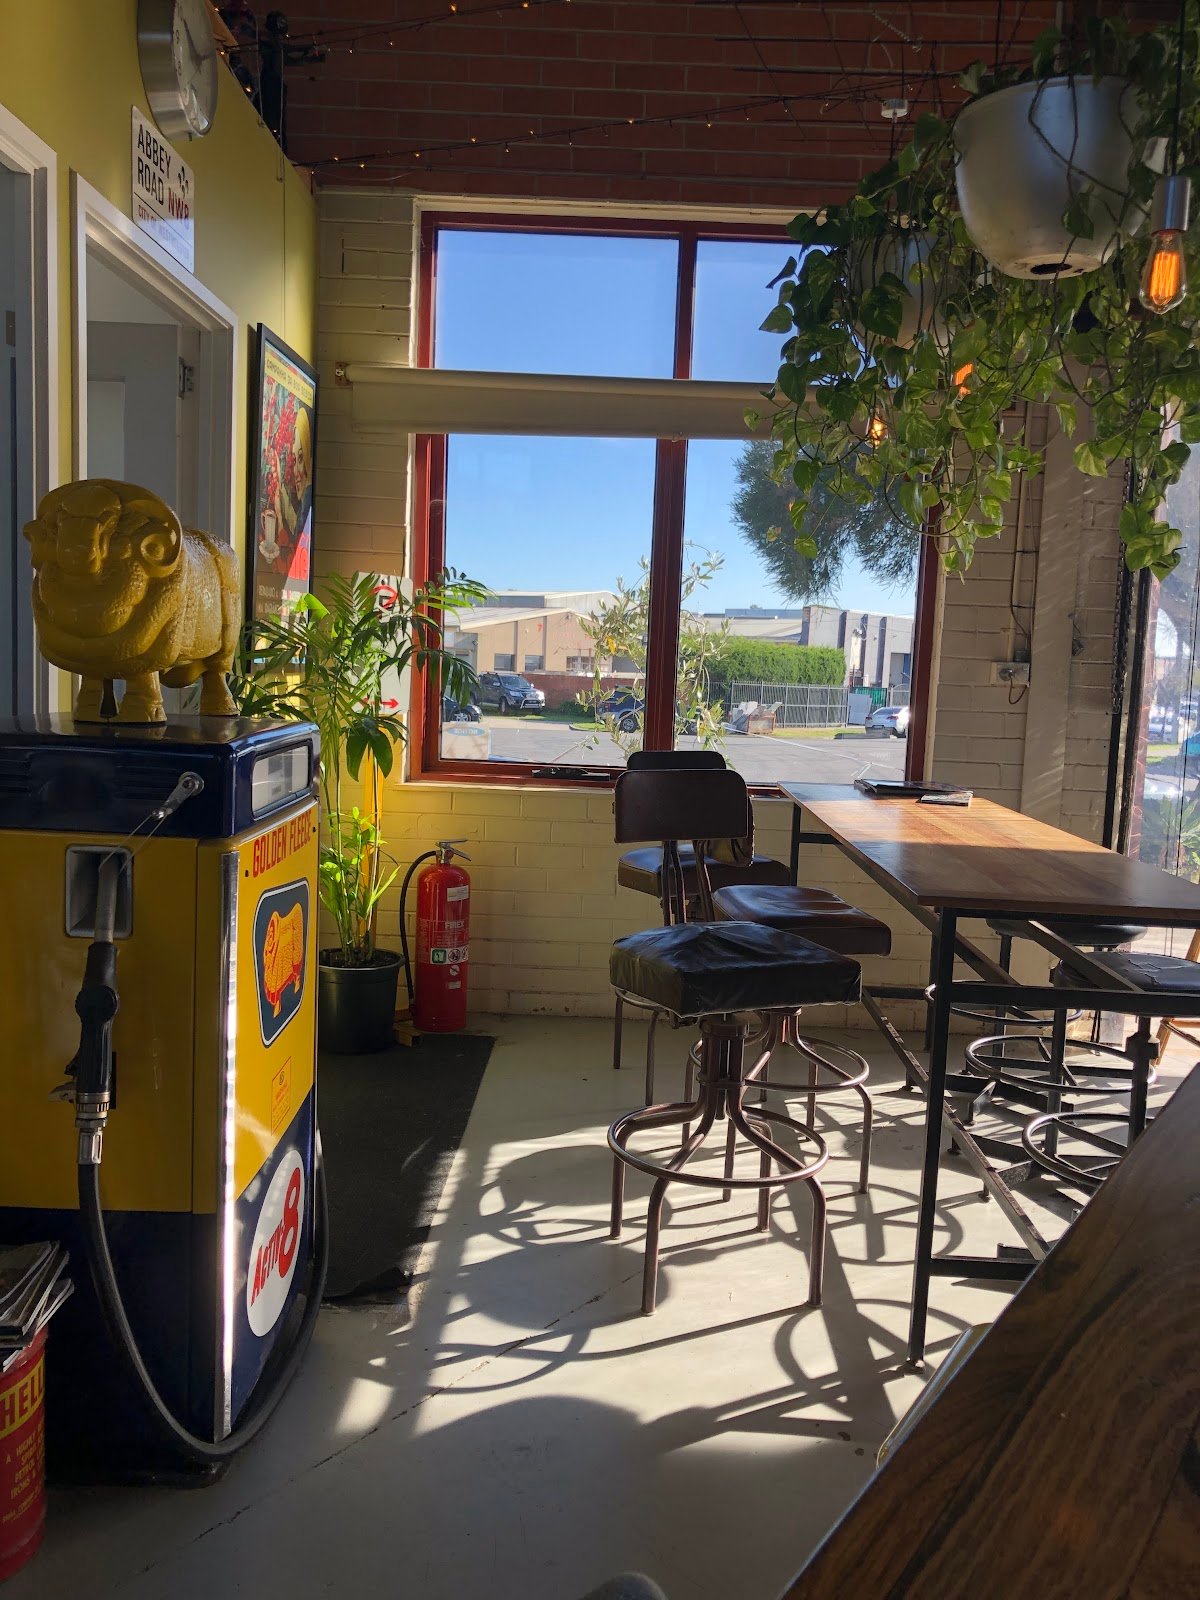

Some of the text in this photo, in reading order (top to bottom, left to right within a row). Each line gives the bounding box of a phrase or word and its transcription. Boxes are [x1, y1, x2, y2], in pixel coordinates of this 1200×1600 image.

[137, 124, 171, 179] ABBEY
[137, 157, 164, 206] ROAD
[138, 204, 150, 222] CITY
[253, 810, 312, 878] GOLDEN FLEECE
